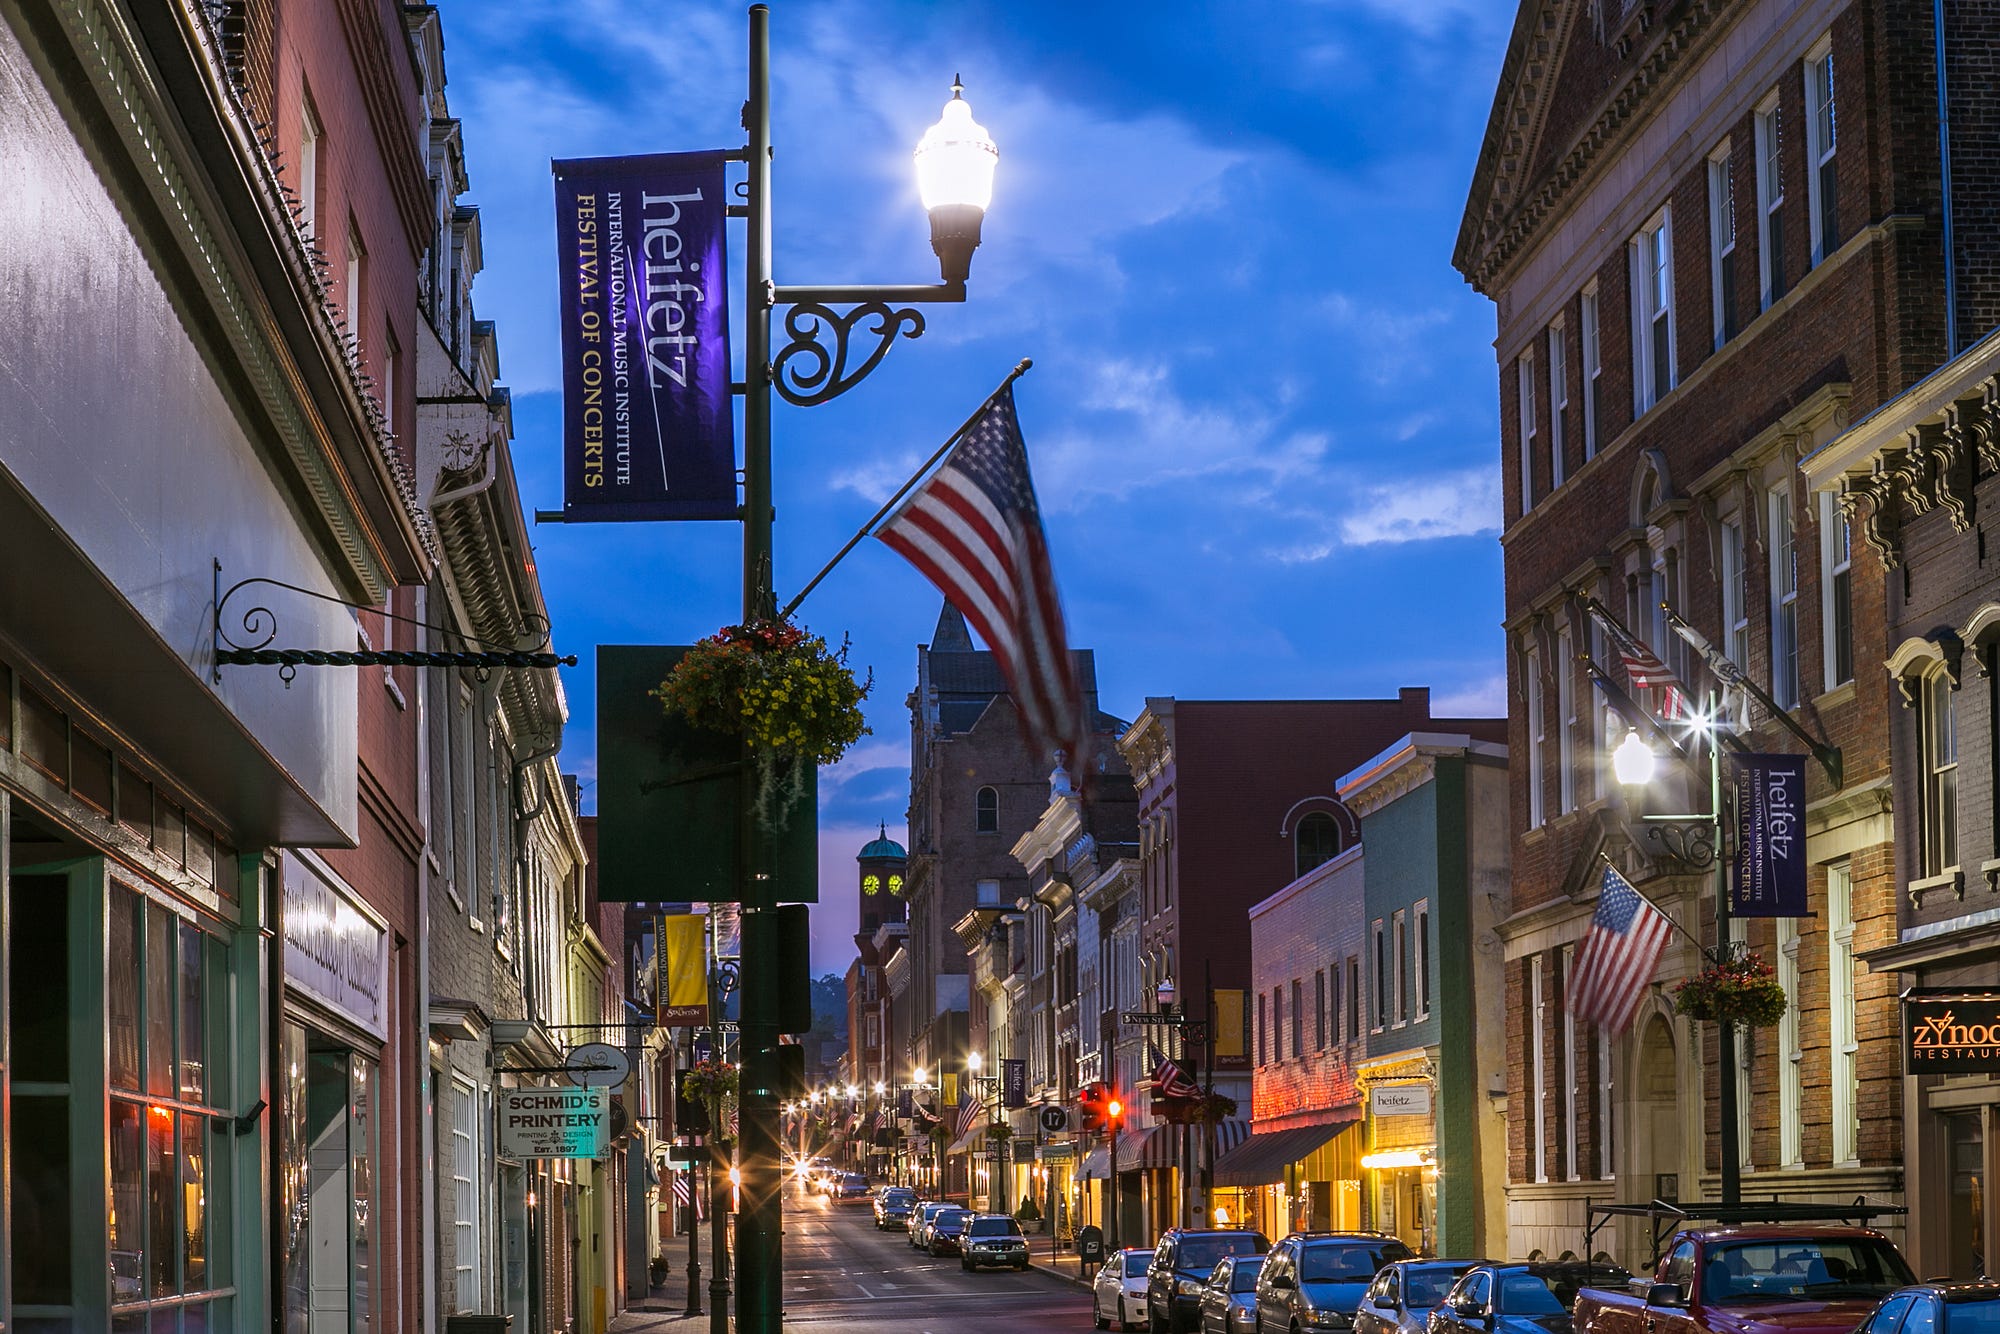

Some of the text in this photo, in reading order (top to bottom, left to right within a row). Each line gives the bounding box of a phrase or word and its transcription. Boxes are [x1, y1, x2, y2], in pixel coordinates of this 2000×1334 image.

[641, 188, 704, 389] heifetz
[577, 194, 603, 488] FESTIVAL OF CONCERTS
[608, 191, 630, 485] INTERNATIONAL MUSIC INSTITUTE
[1754, 768, 1762, 831] INTERNATIONAL
[1768, 770, 1796, 859] heifetz
[1741, 769, 1751, 901] FESTIVAL OF CONCERTS
[1755, 832, 1763, 859] MUSIC
[658, 924, 668, 1005] historic downtown
[1014, 1063, 1023, 1091] heifetz
[509, 1096, 600, 1109] SCHMID'S
[509, 1114, 602, 1128] PRINTERY
[1047, 1113, 1060, 1126] 17
[1377, 1095, 1410, 1105] heifetz
[555, 1145, 577, 1153] 1897
